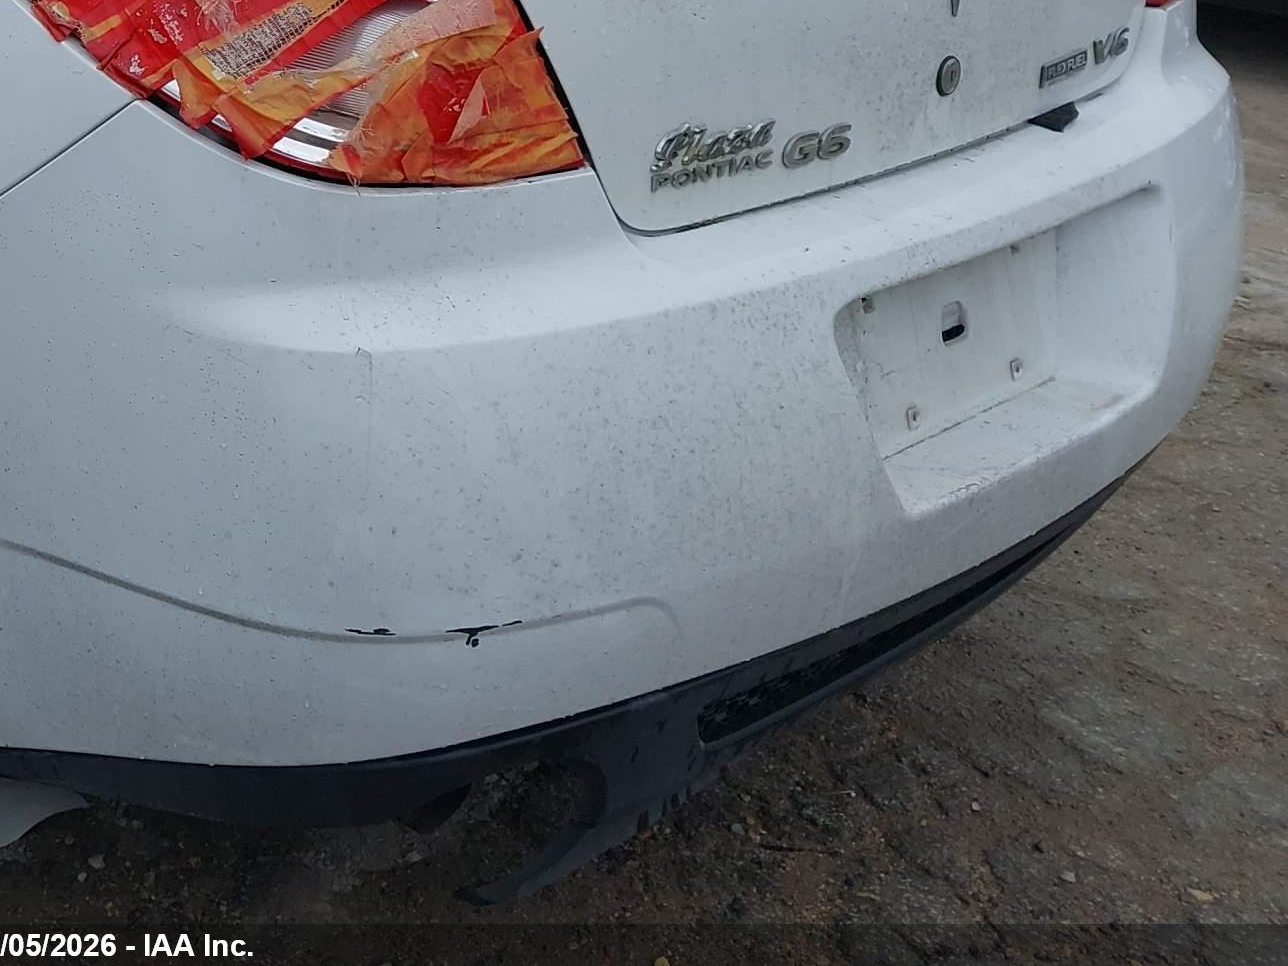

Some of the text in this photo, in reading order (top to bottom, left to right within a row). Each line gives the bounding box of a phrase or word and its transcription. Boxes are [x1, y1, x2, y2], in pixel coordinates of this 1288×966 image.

[1092, 26, 1130, 65] V6
[781, 121, 853, 170] G6
[650, 149, 774, 193] PONTIAC
